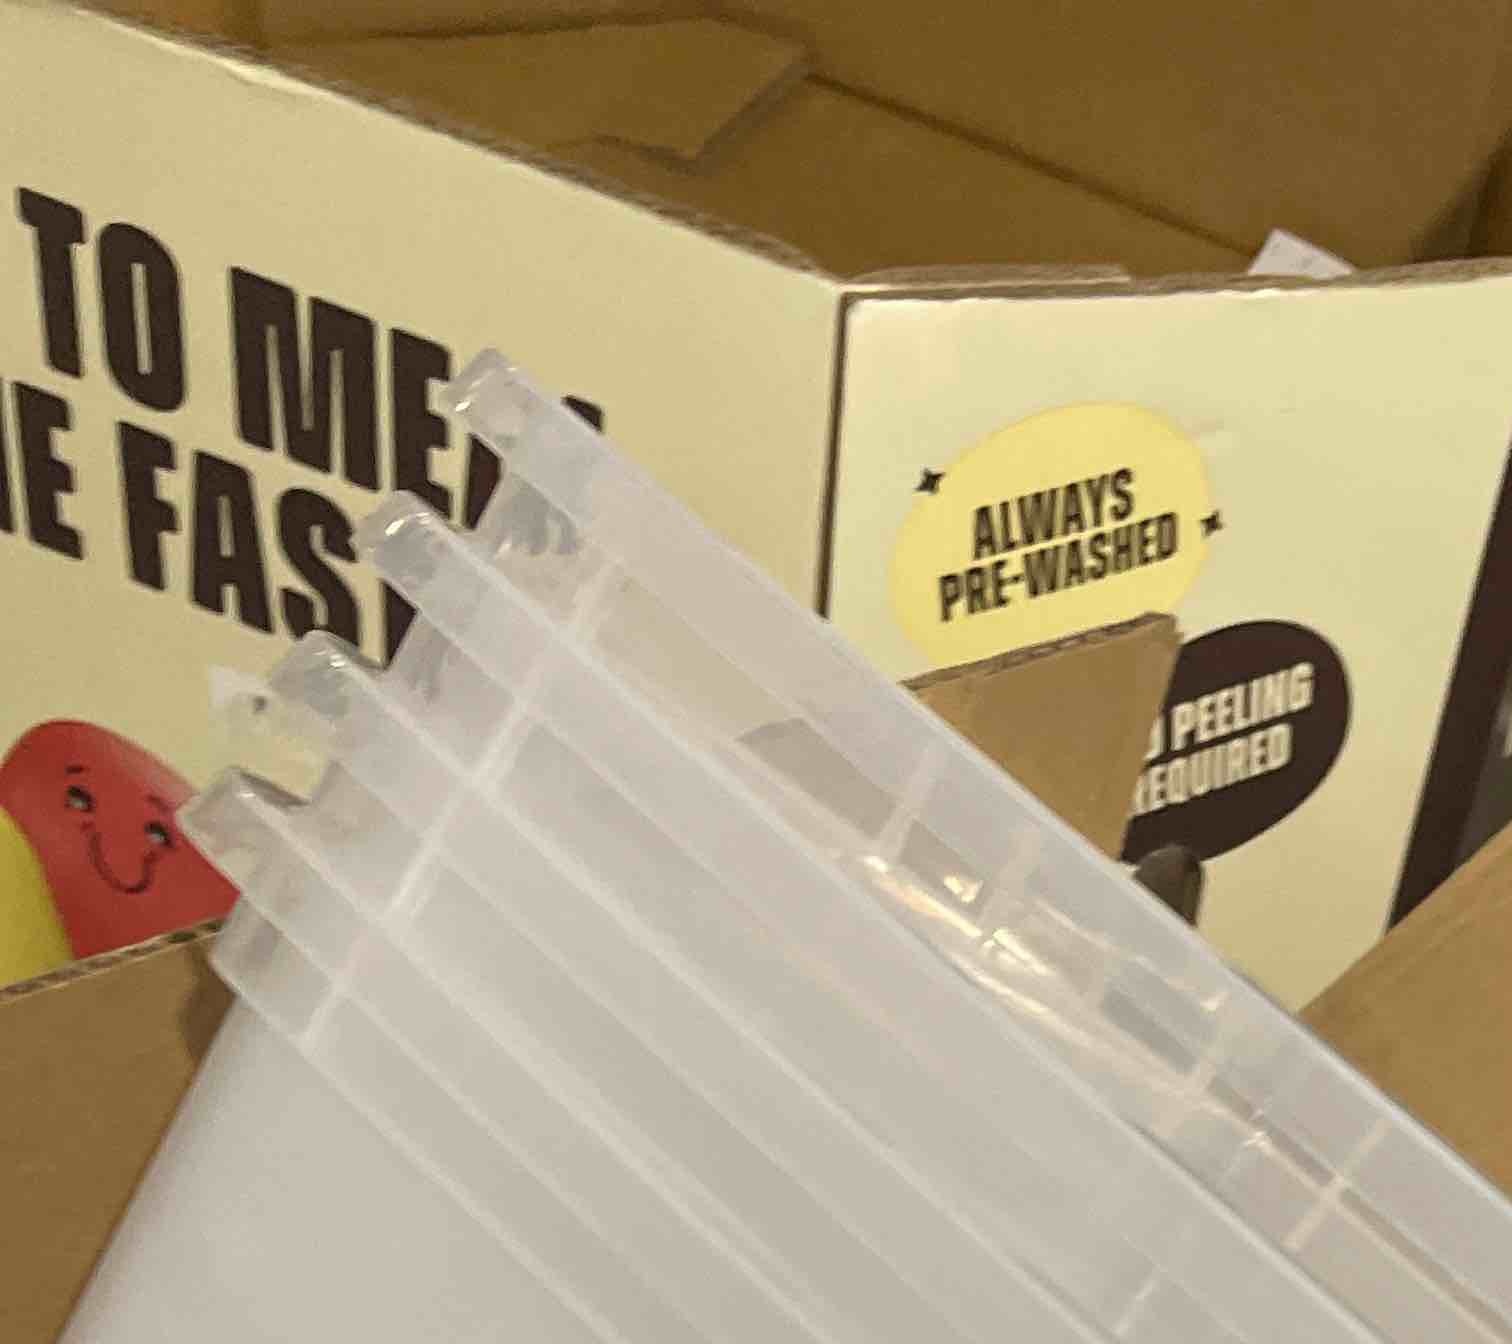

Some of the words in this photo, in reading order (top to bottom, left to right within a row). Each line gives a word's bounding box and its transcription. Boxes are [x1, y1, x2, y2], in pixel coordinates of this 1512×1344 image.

[17, 186, 186, 414] TO
[972, 468, 1134, 560] ALWAYS
[938, 512, 1178, 622] PRE-WASHED
[1171, 662, 1314, 750] PEELING
